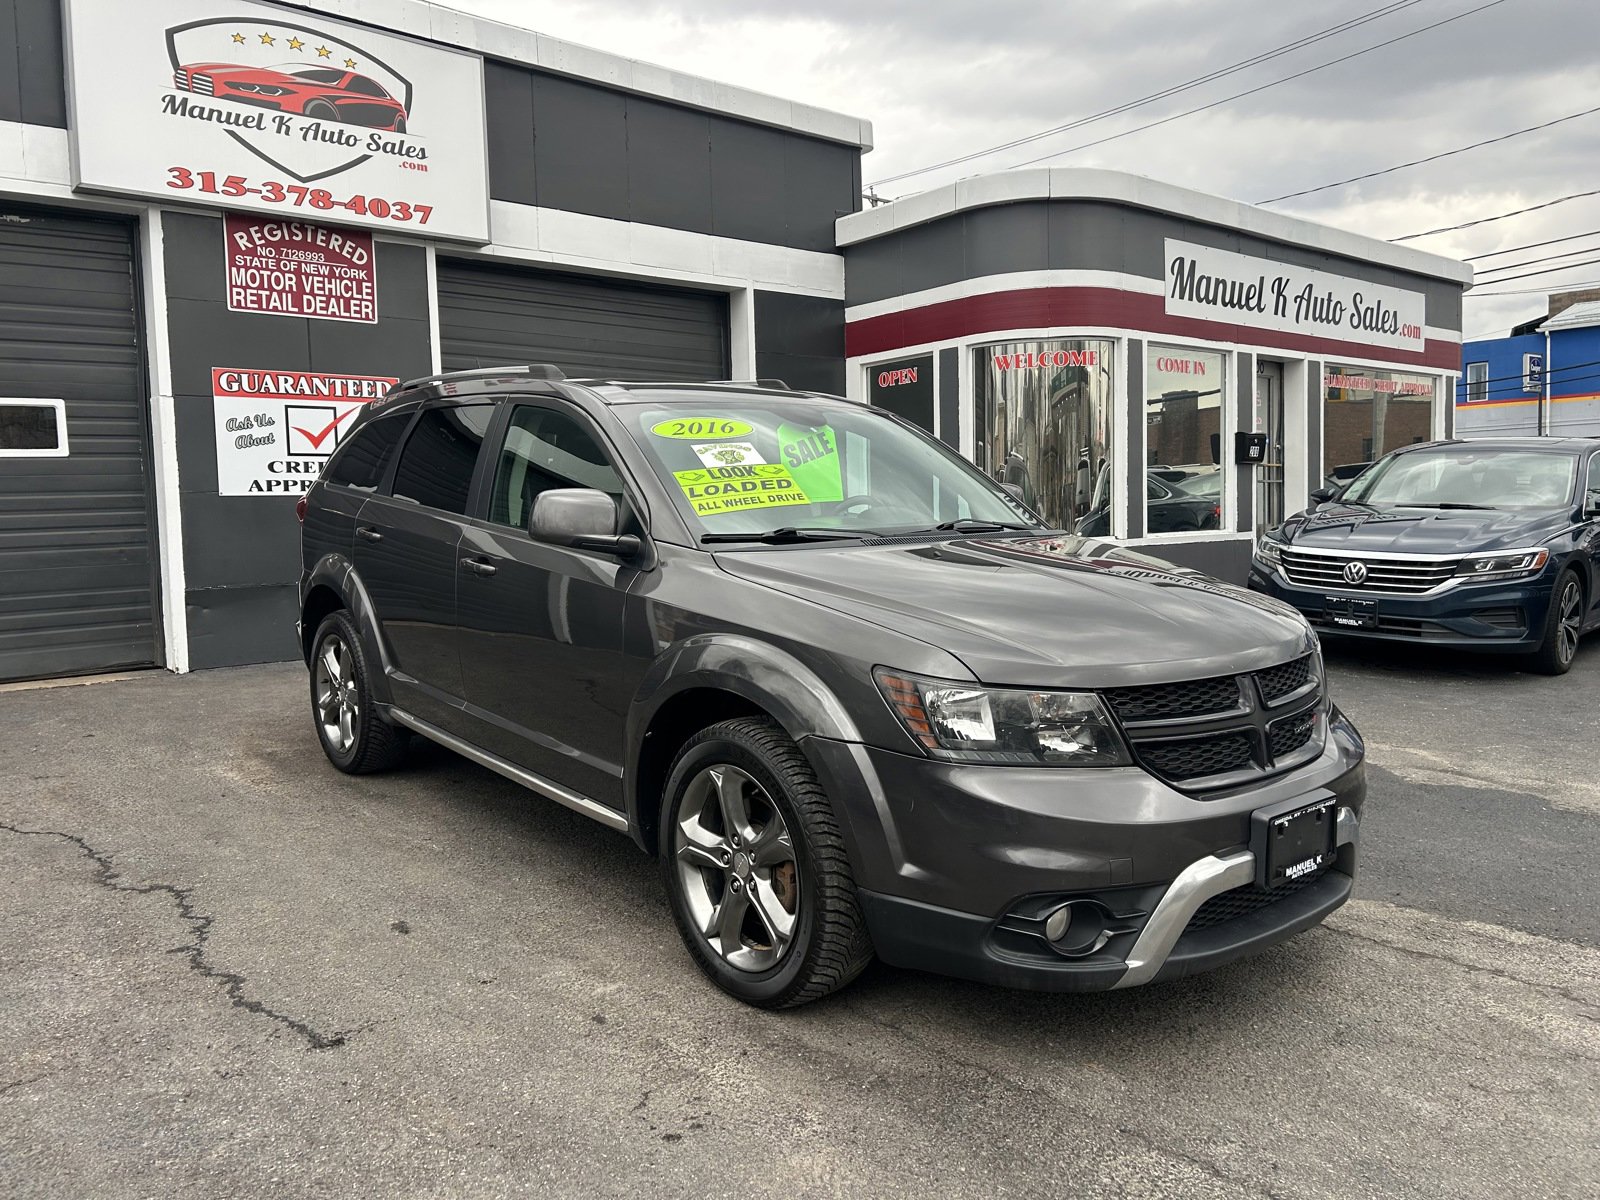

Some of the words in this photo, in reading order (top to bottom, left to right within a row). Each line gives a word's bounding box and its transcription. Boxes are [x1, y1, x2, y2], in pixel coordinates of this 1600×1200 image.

[160, 94, 267, 131] Manuel
[271, 114, 293, 137] K
[299, 121, 363, 148] Auto
[366, 132, 429, 160] Sales
[398, 160, 429, 172] .com
[166, 166, 434, 225] 315-378-4037
[233, 222, 368, 266] REGISTERED
[257, 246, 279, 259] NO.
[280, 247, 325, 262] 7126993
[235, 255, 277, 270] STATE
[280, 260, 298, 272] OF
[301, 263, 329, 276] NEW
[333, 266, 367, 281] YORK
[231, 267, 297, 292] MOTOR
[303, 276, 372, 300] VEHICLE
[232, 287, 298, 312] RETAIL
[303, 295, 373, 319] DEALER
[1170, 256, 1266, 313] Manuel
[1271, 276, 1290, 318] K
[1294, 282, 1346, 325] Auto
[1350, 292, 1400, 336] Sales
[994, 349, 1098, 371] WELCOME
[1156, 356, 1190, 375] COME
[1193, 360, 1206, 376] IN
[218, 371, 393, 399] GUARANTEED
[878, 366, 919, 388] OPEN
[226, 414, 253, 432] Ask
[254, 412, 275, 428] Us
[671, 421, 734, 436] 2016
[235, 433, 275, 450] About
[783, 431, 834, 469] SALE
[706, 465, 760, 480] LOOK
[248, 479, 314, 493] APPR
[688, 478, 793, 499] LOADED
[698, 501, 721, 512] ALL
[725, 496, 765, 508] WHEEL
[768, 492, 806, 503] DRIVE
[1286, 858, 1315, 877] MANUEL
[1316, 854, 1323, 864] K
